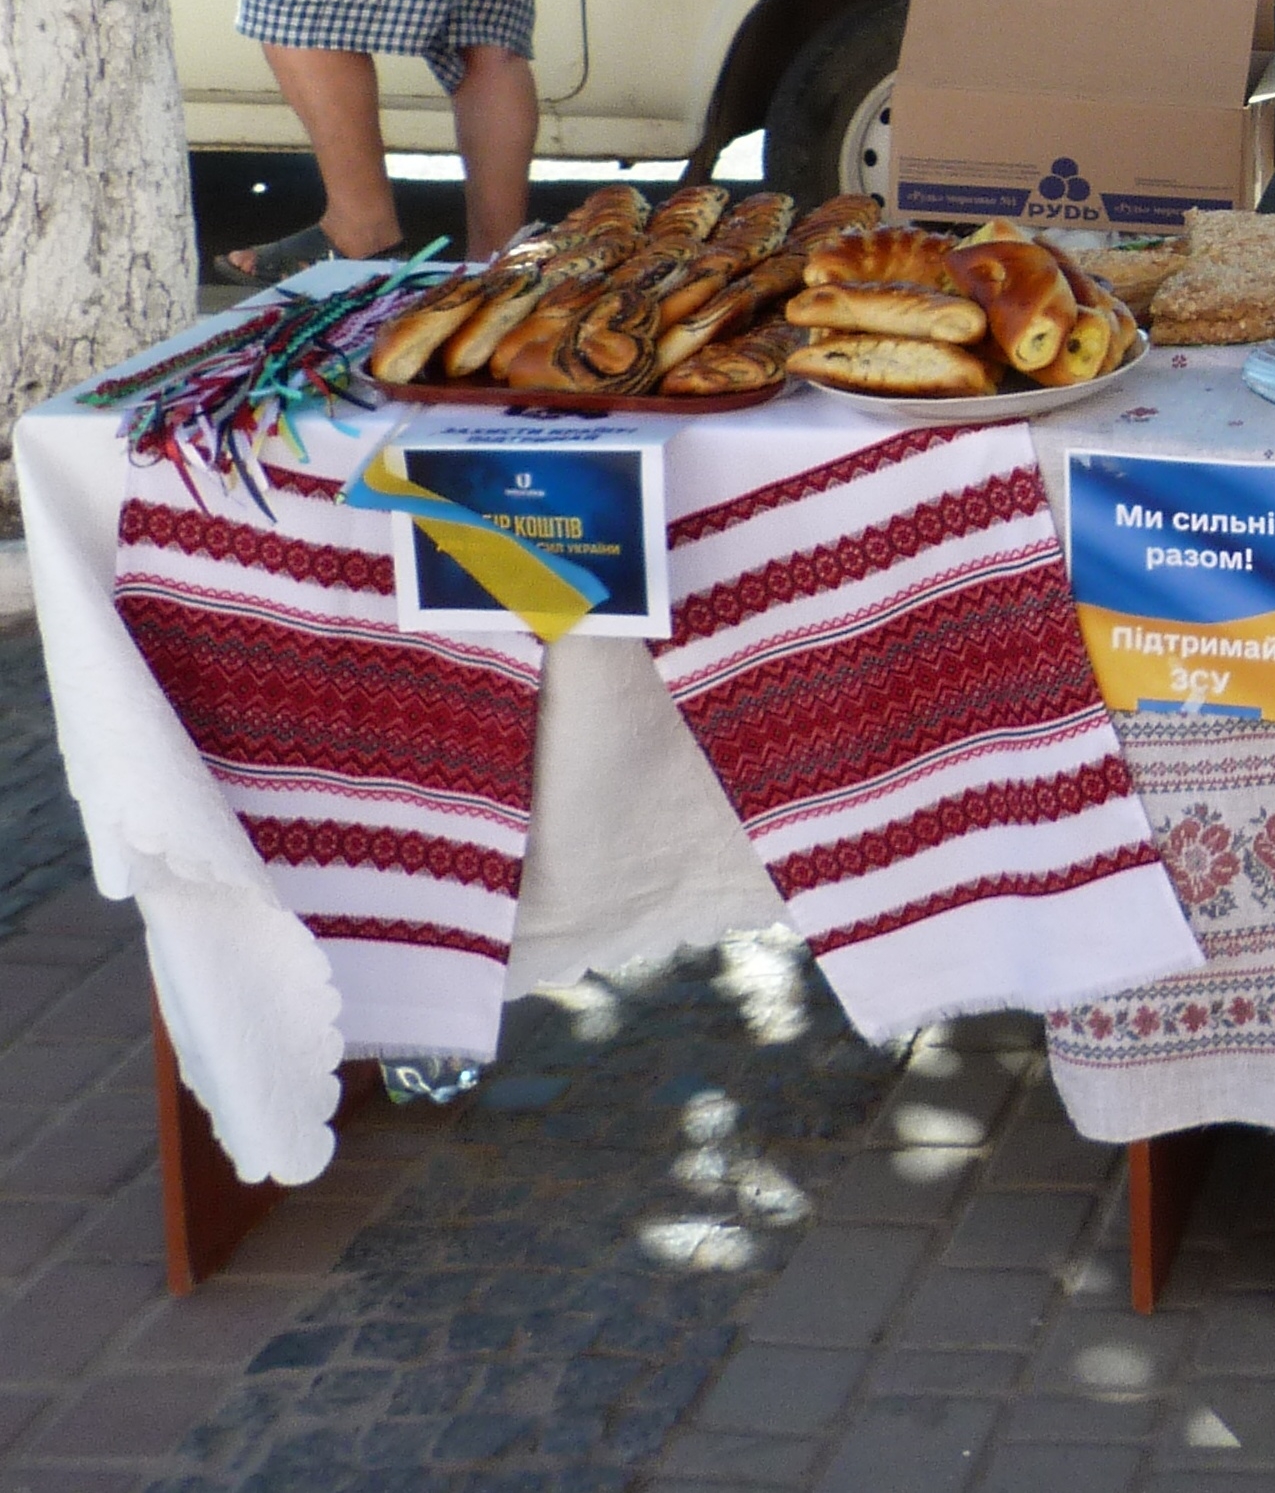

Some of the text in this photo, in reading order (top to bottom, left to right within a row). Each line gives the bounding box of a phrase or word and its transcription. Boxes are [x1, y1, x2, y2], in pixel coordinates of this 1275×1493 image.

[514, 515, 584, 539] КОШТІВ
[1115, 504, 1275, 536] Ми сильні
[1146, 546, 1253, 571] разом!
[1170, 667, 1231, 694] ЗСУ
